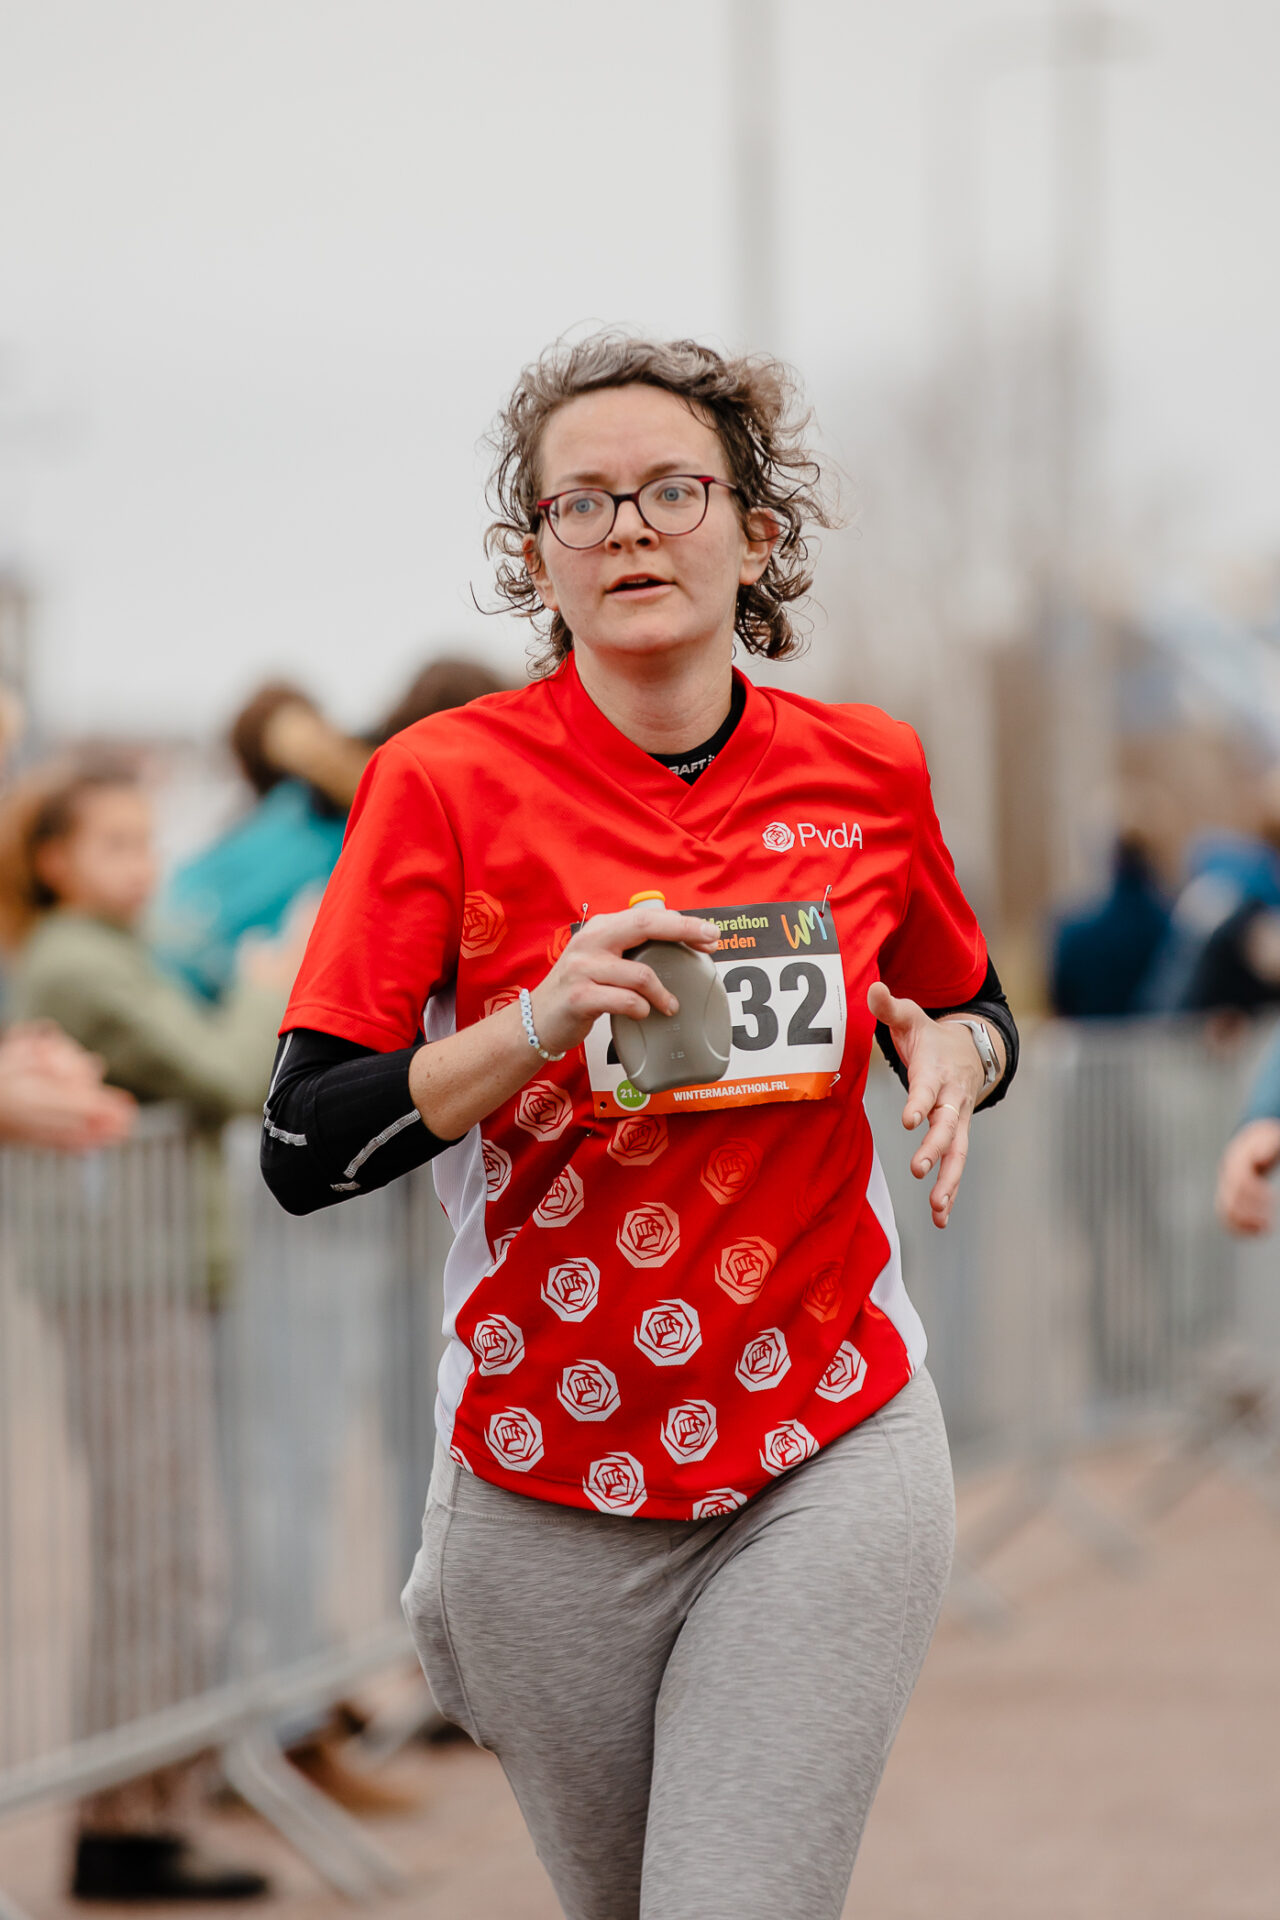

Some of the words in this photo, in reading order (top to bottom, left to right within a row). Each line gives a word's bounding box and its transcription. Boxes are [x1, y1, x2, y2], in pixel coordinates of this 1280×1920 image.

[668, 758, 707, 775] RAFT
[797, 822, 863, 849] PvdA
[716, 933, 757, 951] arden
[673, 1080, 790, 1102] WINTERMARATHON.FRL
